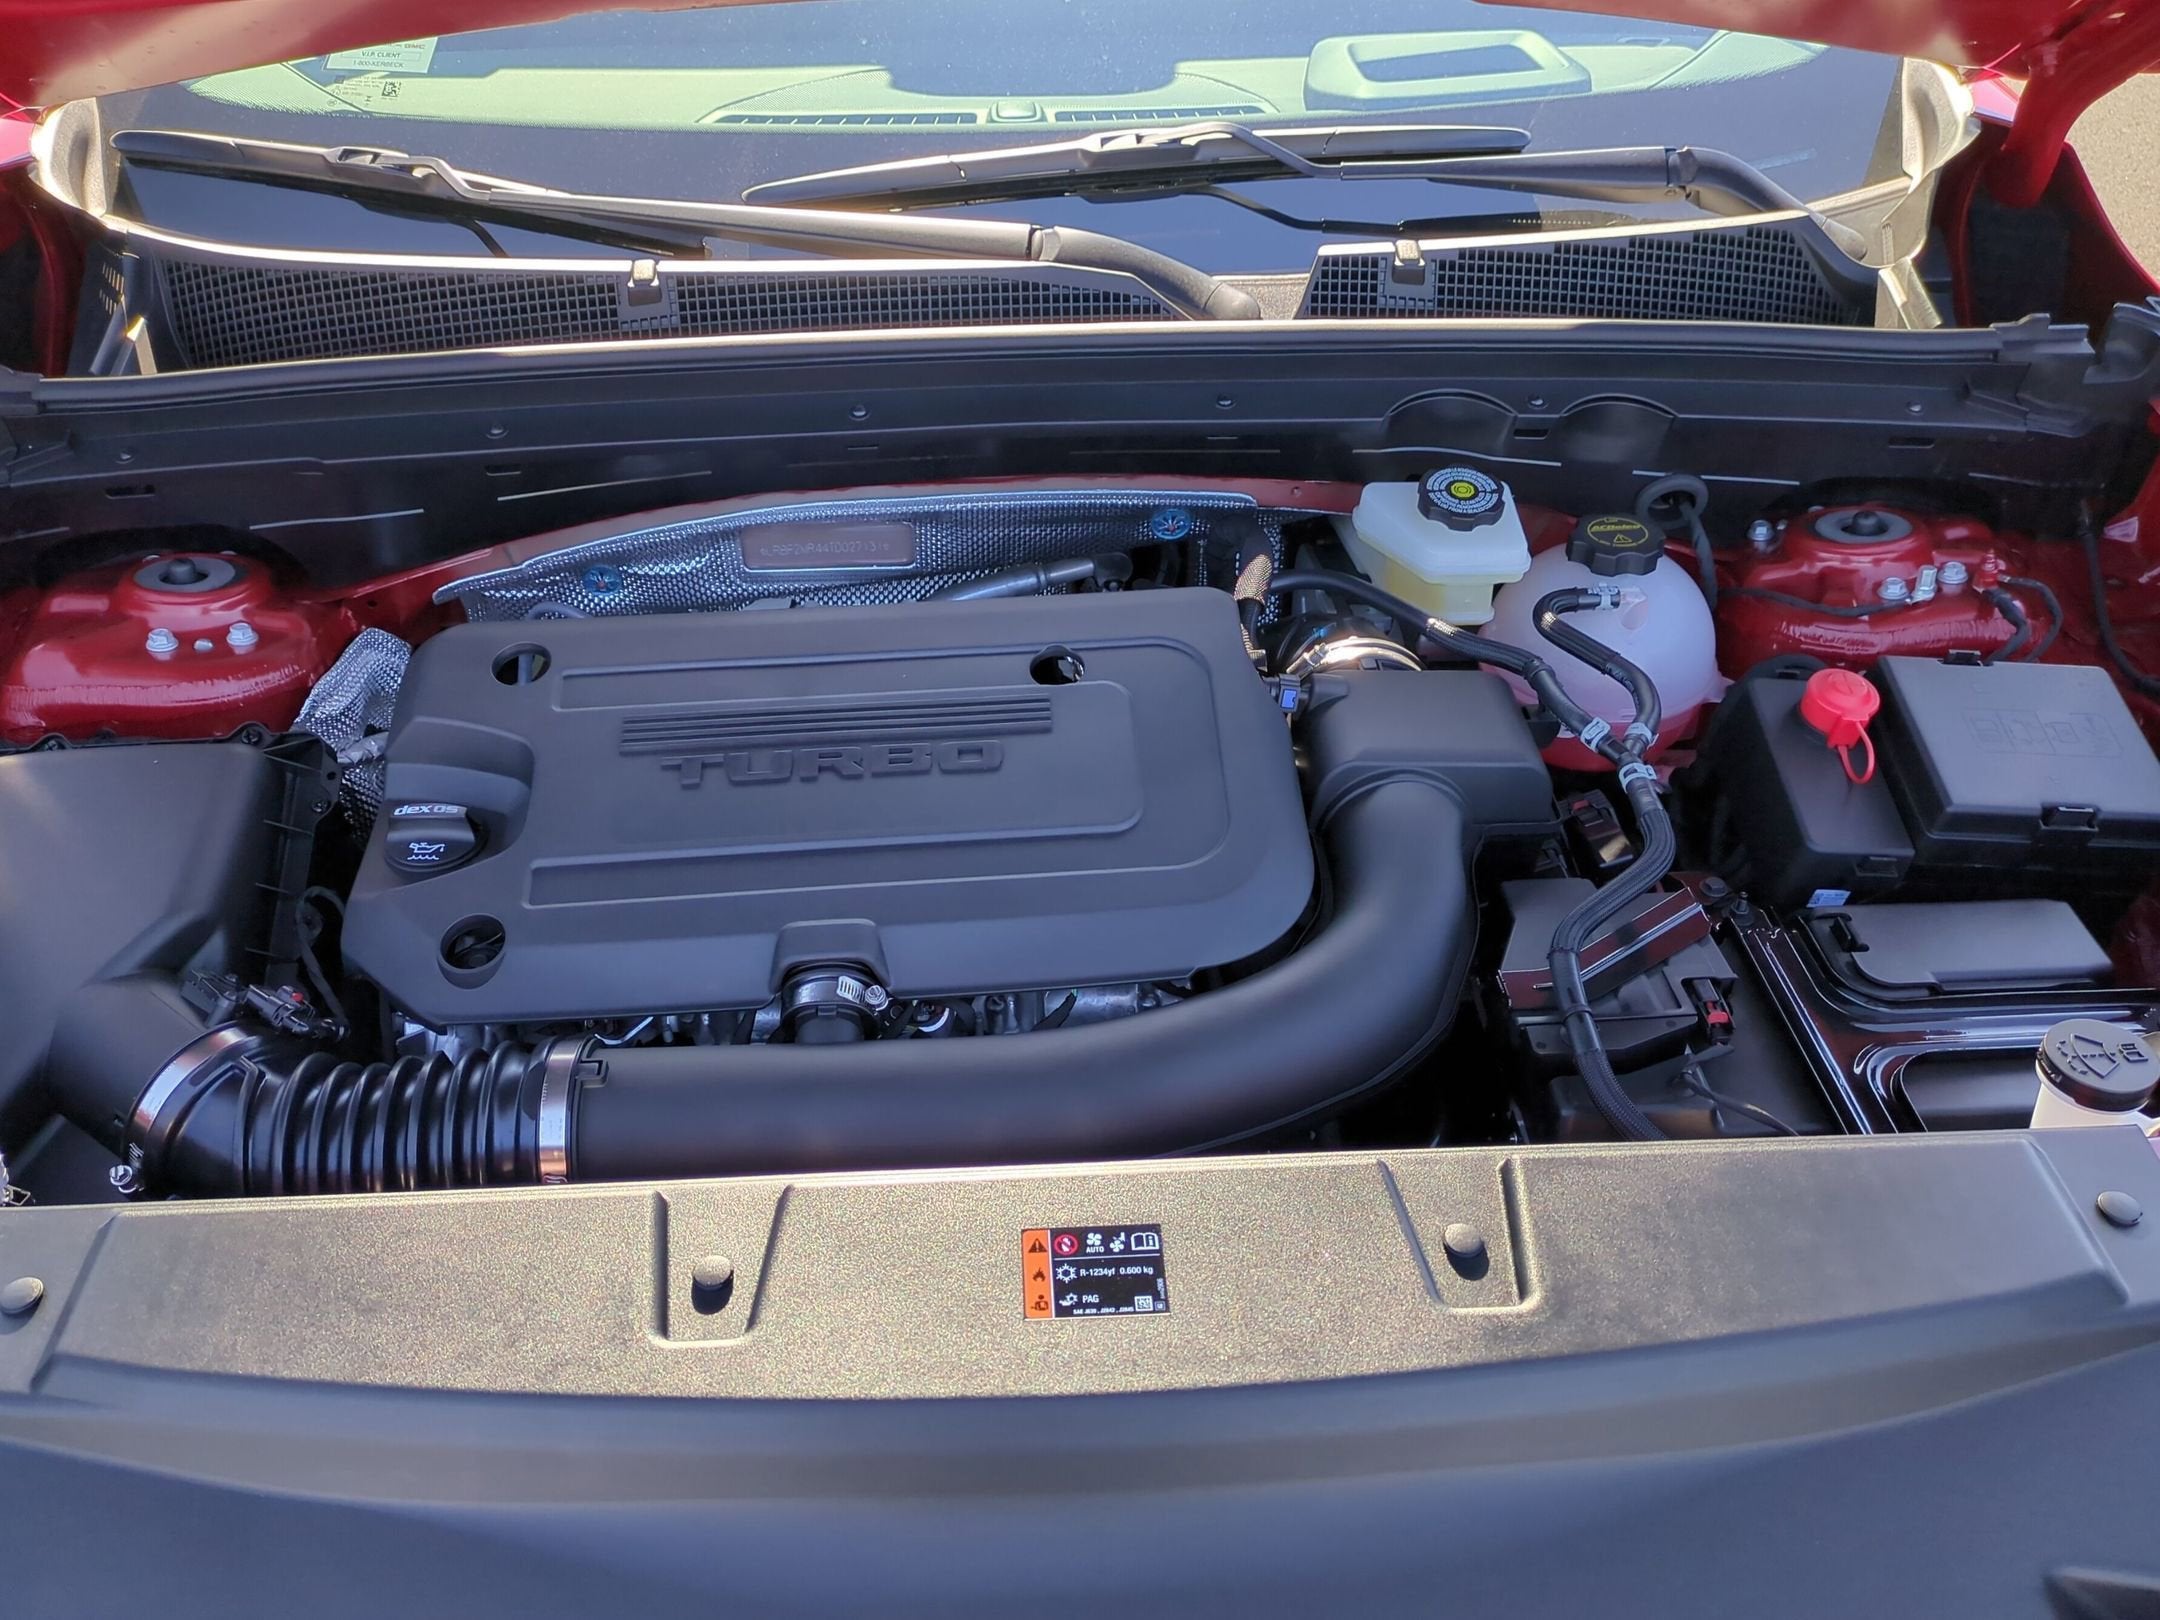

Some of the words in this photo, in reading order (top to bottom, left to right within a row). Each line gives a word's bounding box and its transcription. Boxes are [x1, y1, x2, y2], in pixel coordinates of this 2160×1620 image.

[661, 740, 1002, 789] TURBO
[1080, 1267, 1115, 1276] R-1234yf
[1120, 1266, 1142, 1275] 0.600
[1143, 1266, 1153, 1275] kg
[1082, 1294, 1099, 1303] PAG
